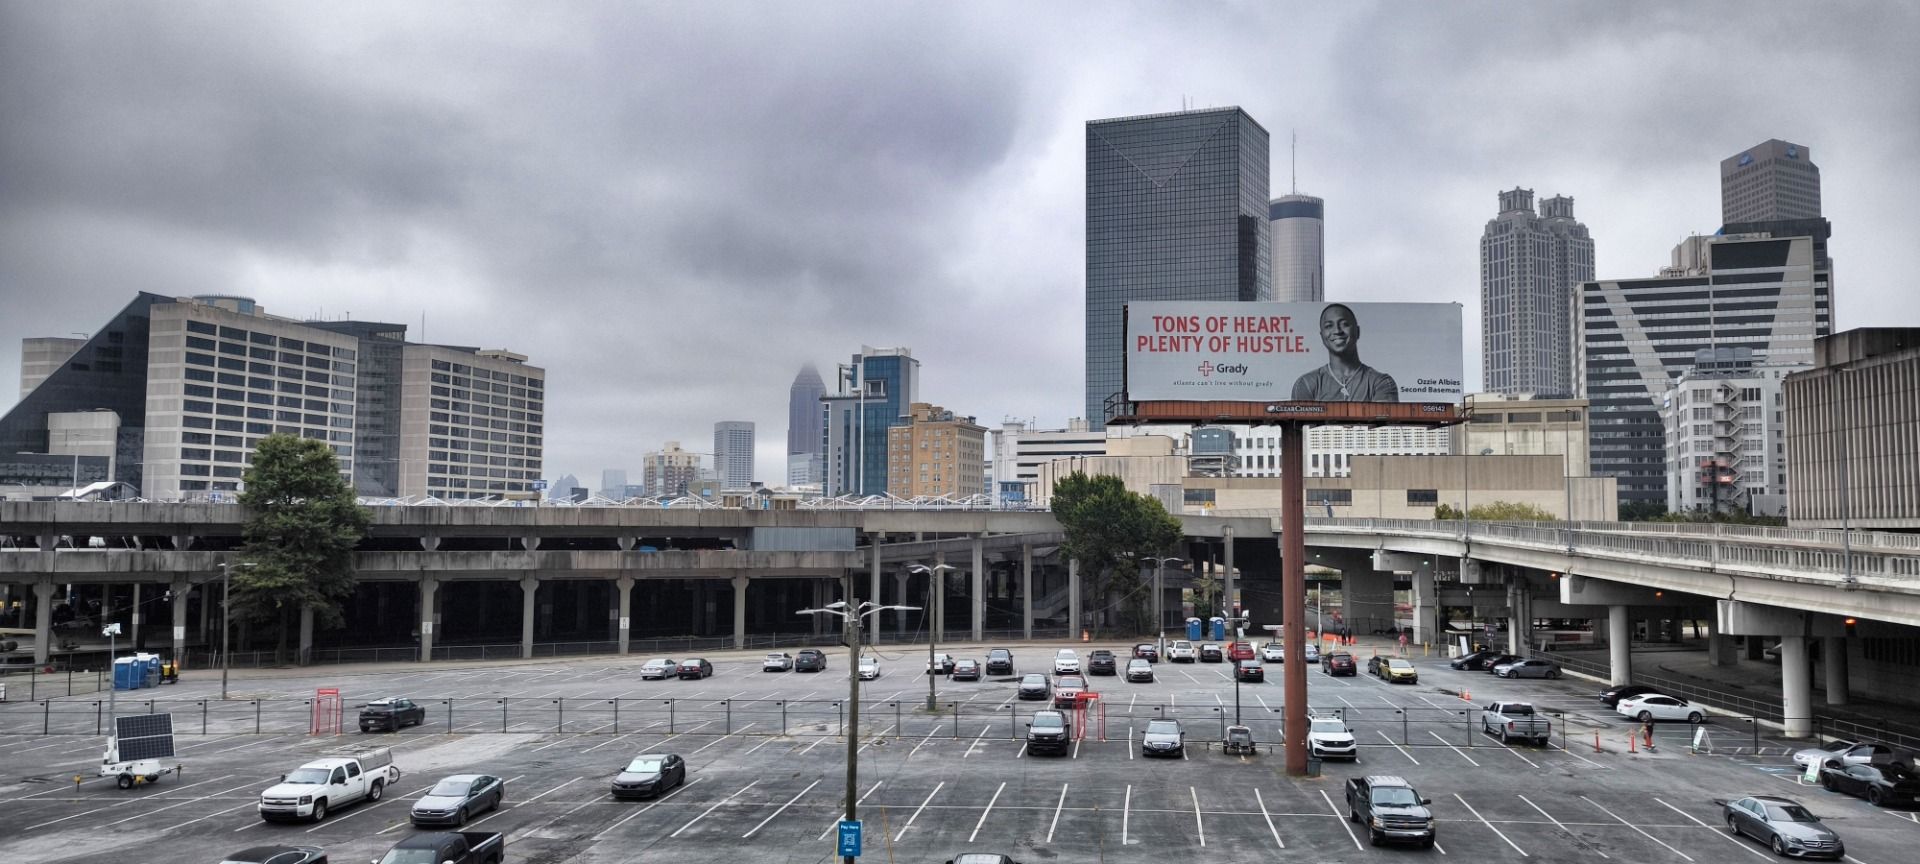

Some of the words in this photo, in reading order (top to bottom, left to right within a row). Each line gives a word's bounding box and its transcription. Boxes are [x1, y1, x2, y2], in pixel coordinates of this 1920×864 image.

[1152, 316, 1200, 333] TONS
[1206, 316, 1229, 333] OF
[1234, 316, 1293, 333] HEART.
[1137, 336, 1204, 352] PLENTY
[1208, 336, 1231, 352] OF
[1236, 336, 1310, 353] HUSTLE.
[1216, 363, 1248, 376] Grady
[1255, 380, 1273, 388] grady
[1438, 378, 1461, 386] Albies
[1428, 386, 1461, 394] Baseman
